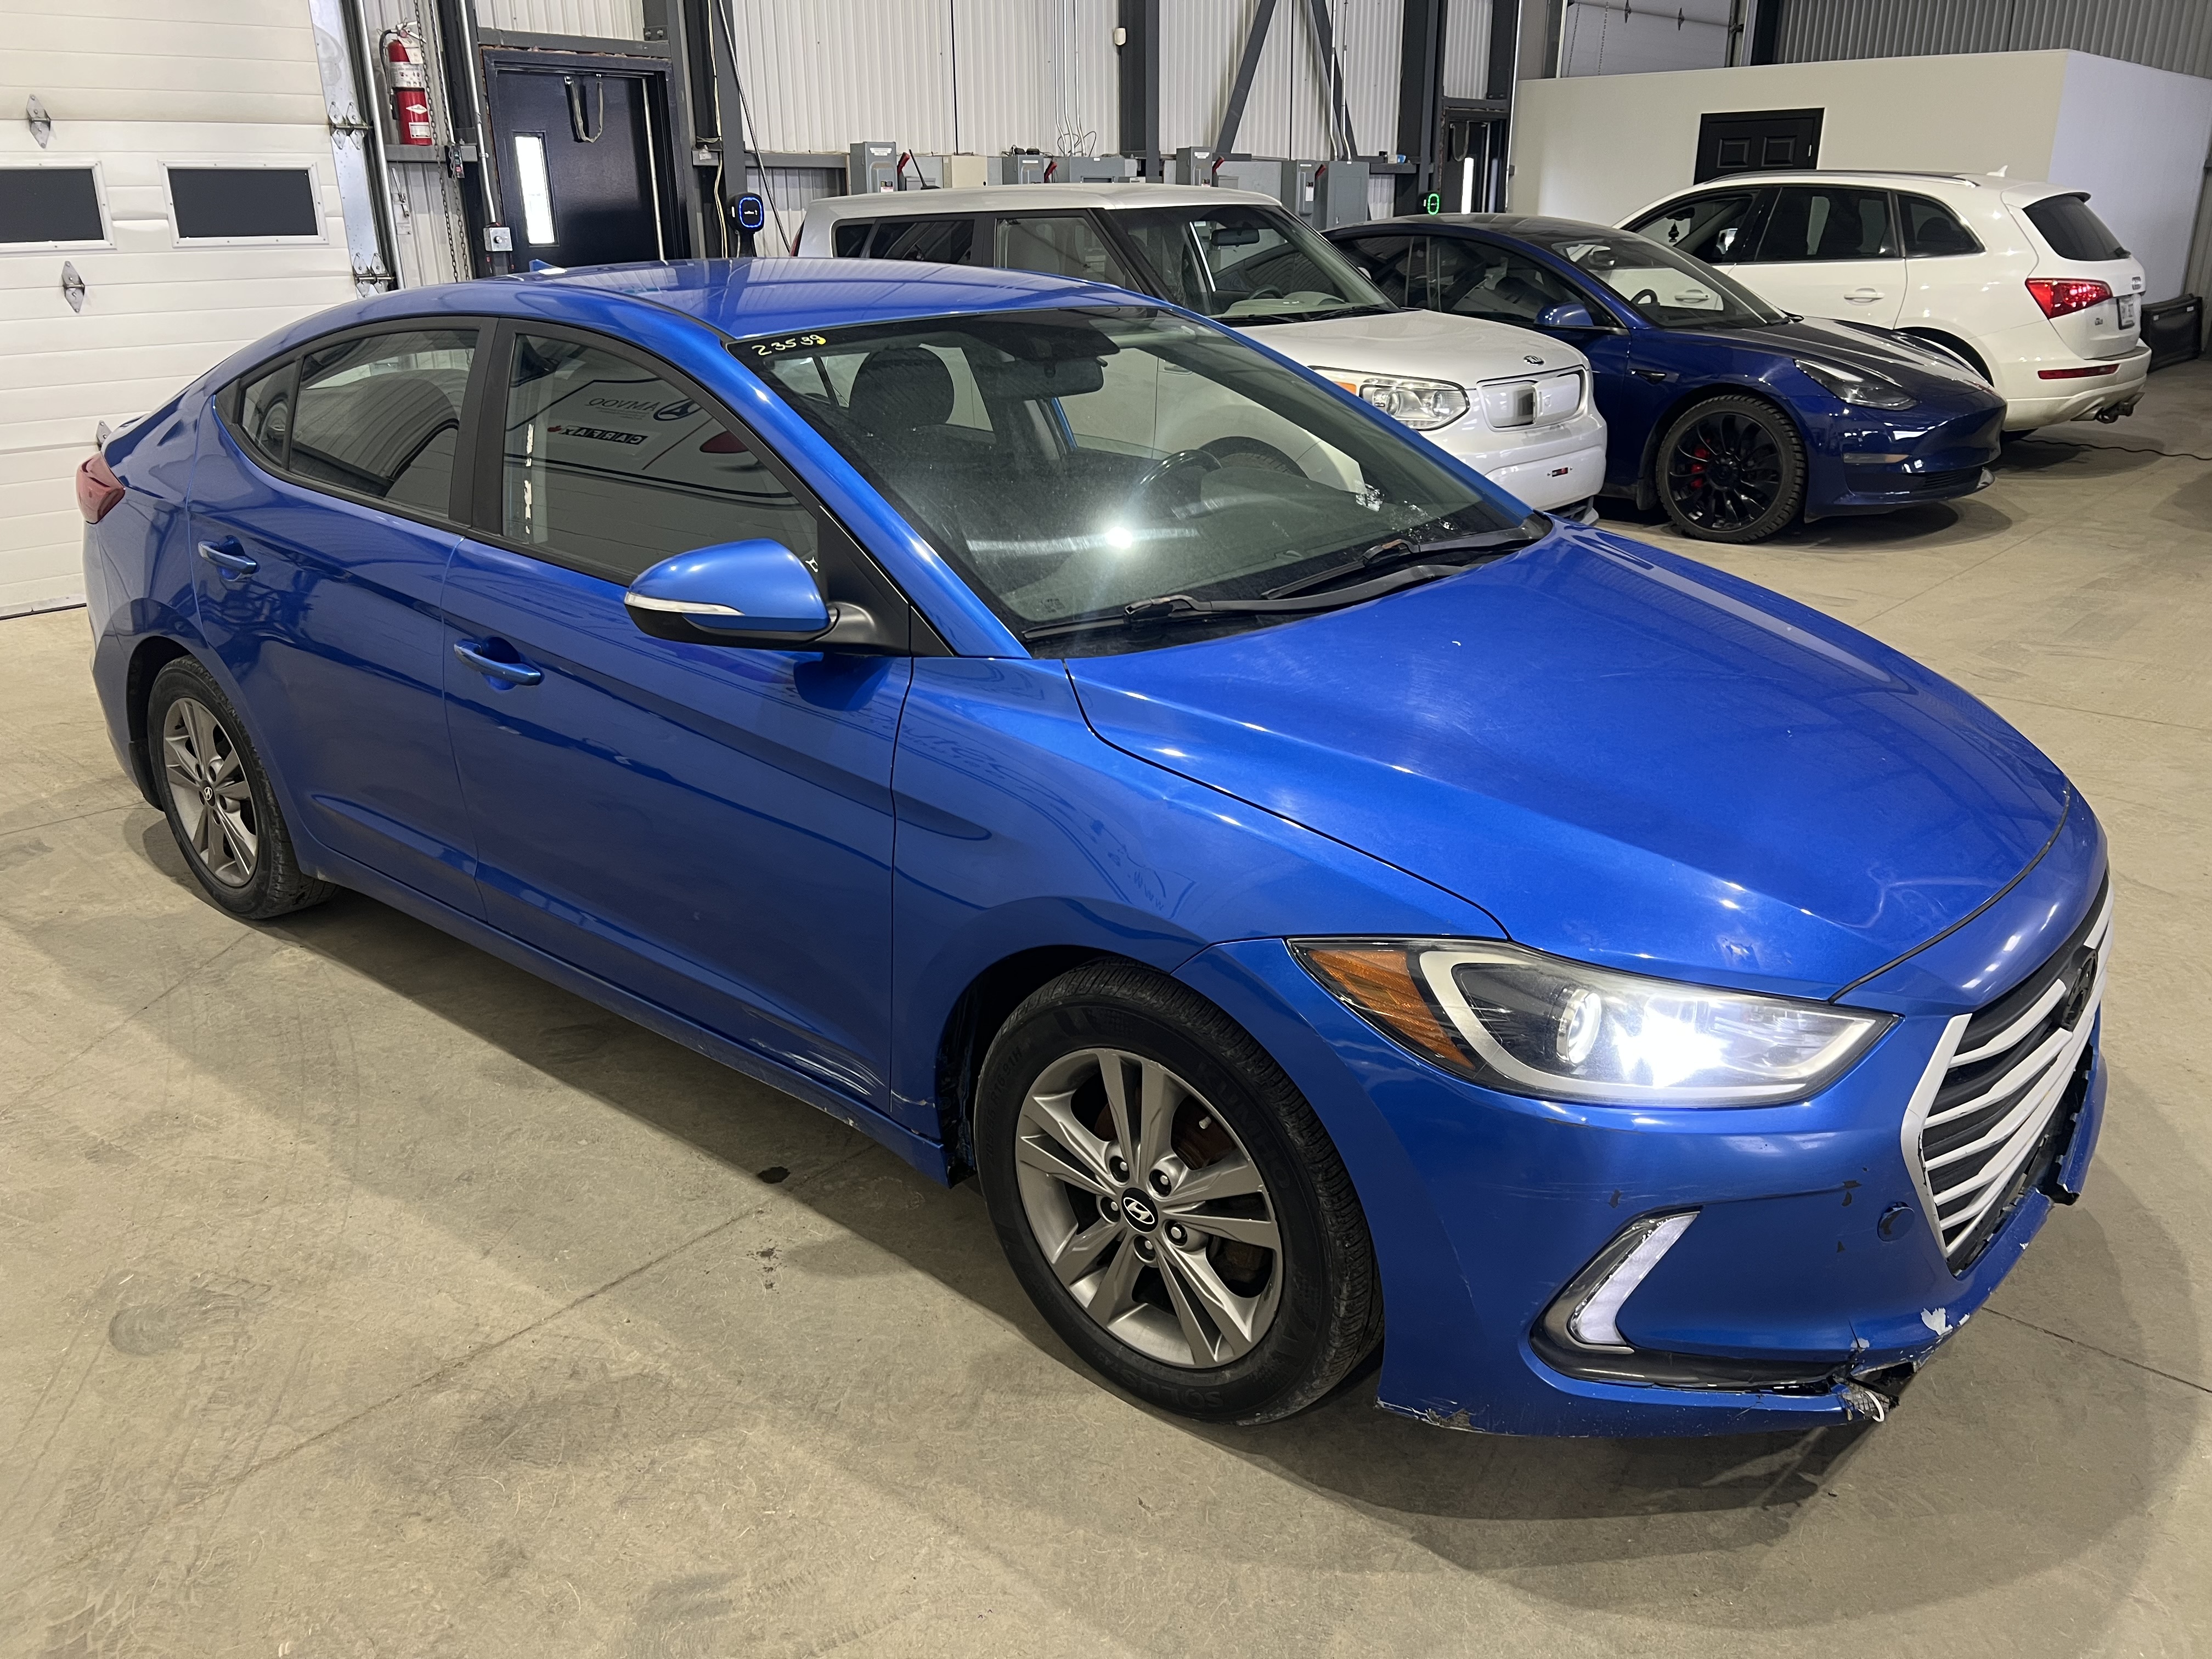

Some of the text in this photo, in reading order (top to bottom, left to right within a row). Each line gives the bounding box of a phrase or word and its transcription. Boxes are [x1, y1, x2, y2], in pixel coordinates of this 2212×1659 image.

[990, 1075, 1007, 1107] R16
[1002, 1045, 1023, 1076] 91H
[1198, 1061, 1290, 1189] KUMHO
[1123, 1369, 1224, 1408] SOLUS
